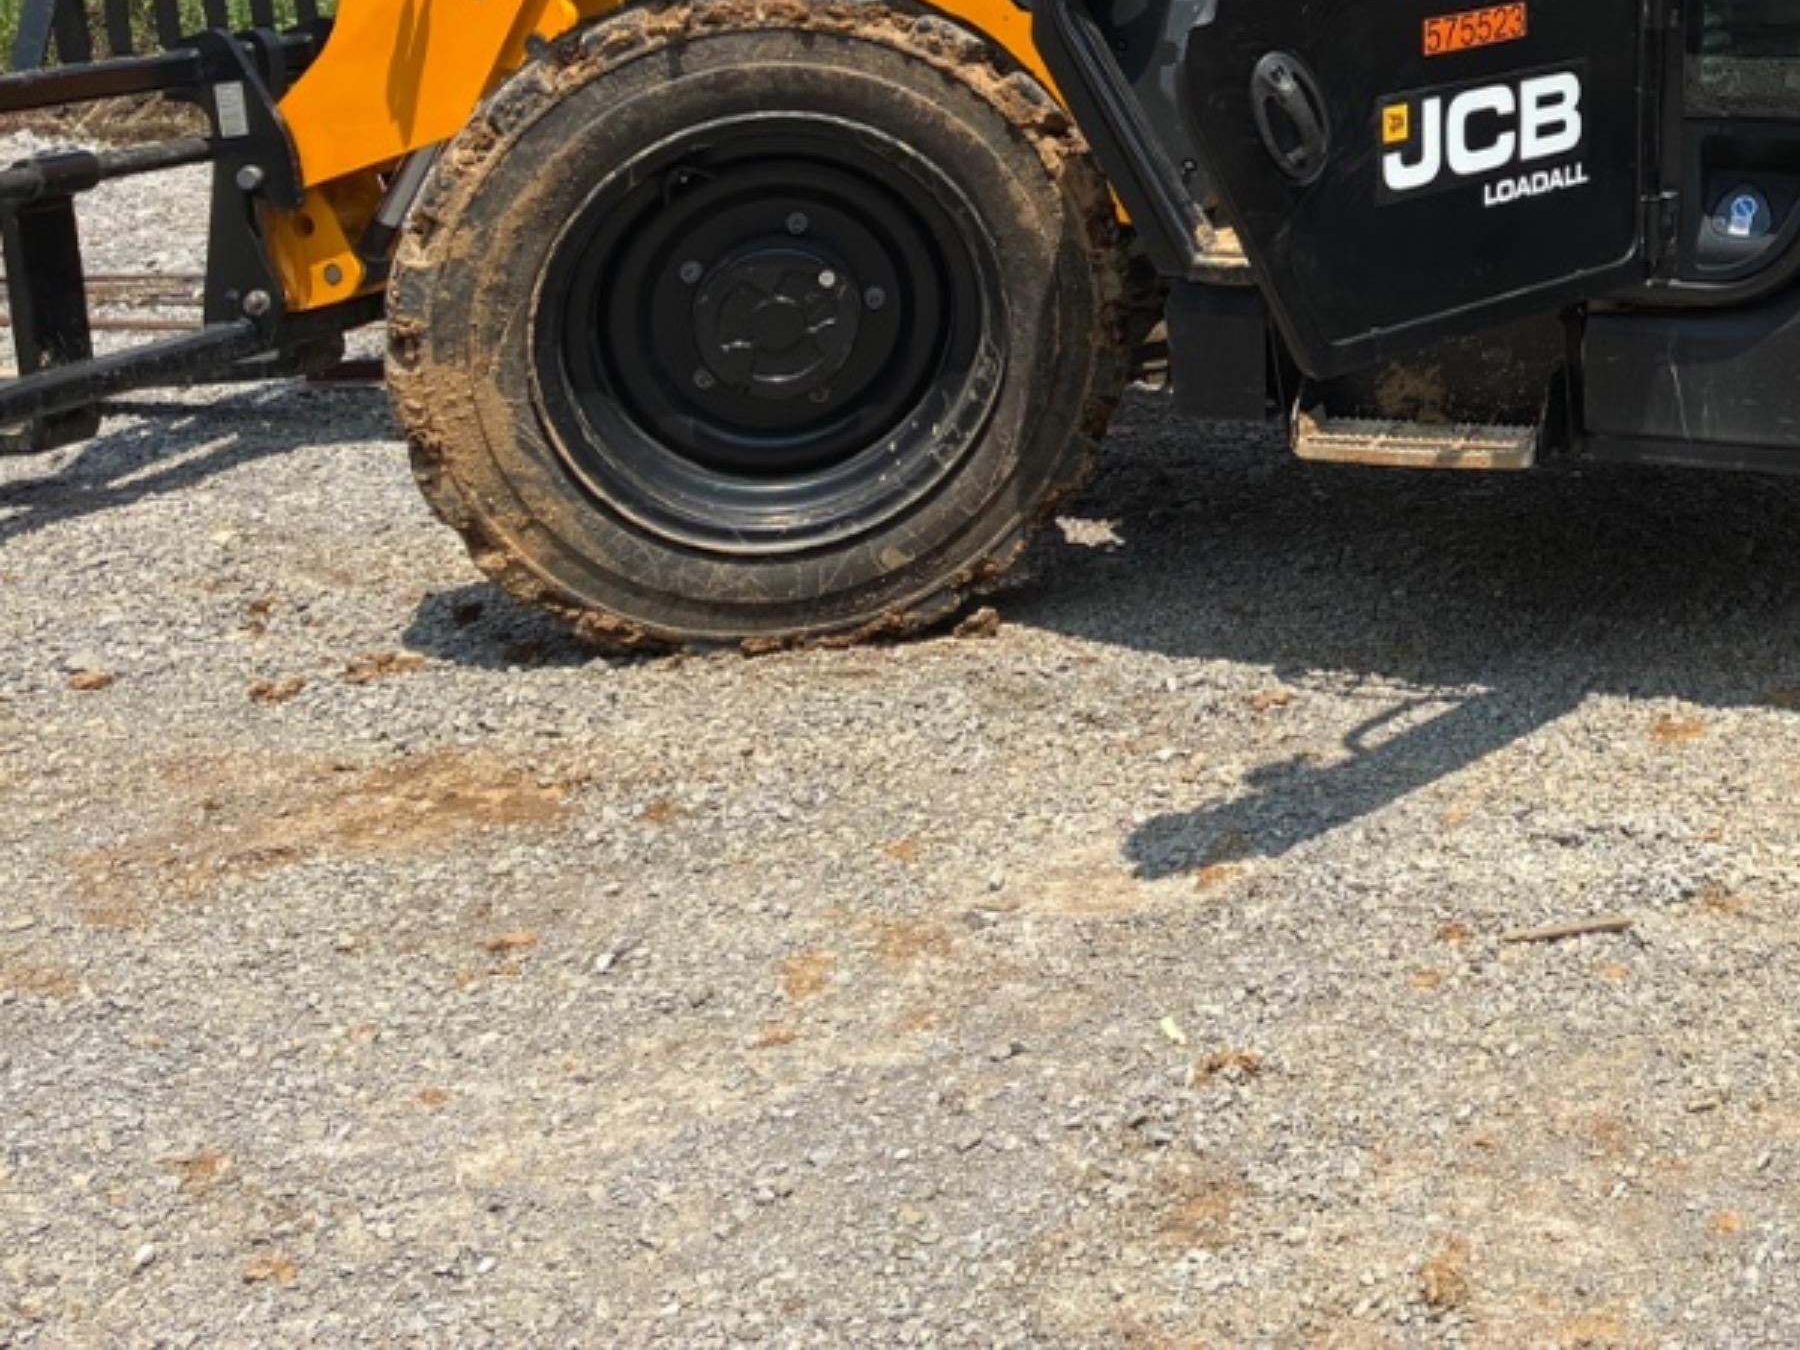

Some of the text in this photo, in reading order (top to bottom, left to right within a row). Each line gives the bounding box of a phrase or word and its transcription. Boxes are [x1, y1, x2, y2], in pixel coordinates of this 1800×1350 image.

[1426, 5, 1524, 52] 575523
[1382, 72, 1582, 190] JCB
[1484, 162, 1590, 207] LOADALL
